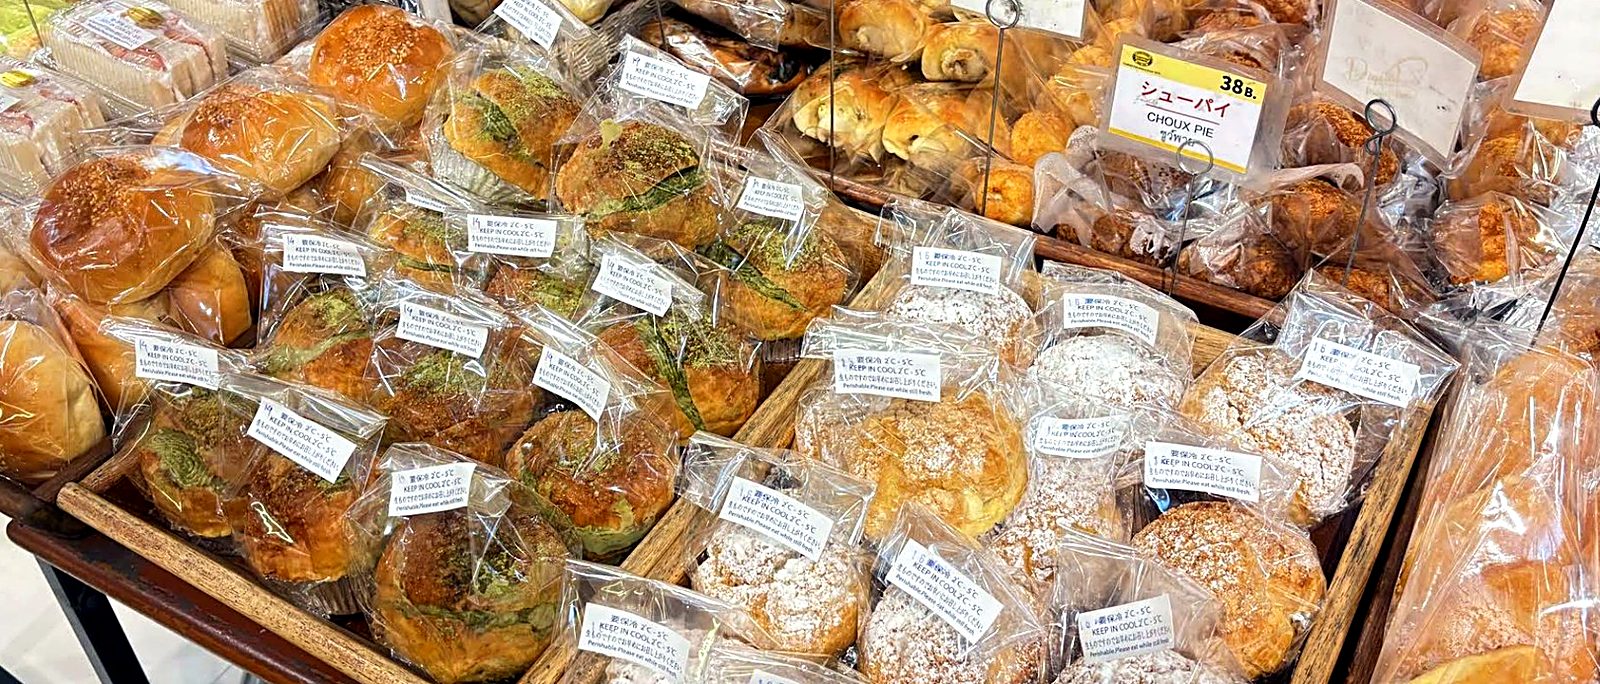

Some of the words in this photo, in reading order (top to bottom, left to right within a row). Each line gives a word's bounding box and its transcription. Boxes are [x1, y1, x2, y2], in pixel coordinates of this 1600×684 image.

[1142, 81, 1230, 117] シューパイ
[1147, 112, 1191, 132] CHOUX
[1194, 125, 1214, 138] PIE
[877, 366, 899, 374] COOL
[1161, 457, 1179, 466] KEEP
[1181, 460, 1189, 468] IN
[1191, 461, 1215, 472] COOL
[742, 494, 759, 507] KEEP
[761, 502, 768, 510] IN
[771, 505, 791, 520] COOL
[912, 561, 929, 577] KEEP
[931, 574, 938, 583] IN
[940, 580, 959, 598] COOL
[600, 622, 617, 632] KEEP
[620, 626, 627, 635] IN
[630, 629, 650, 644] COOL
[1092, 626, 1107, 634] KEEP
[1119, 621, 1138, 630] COOL
